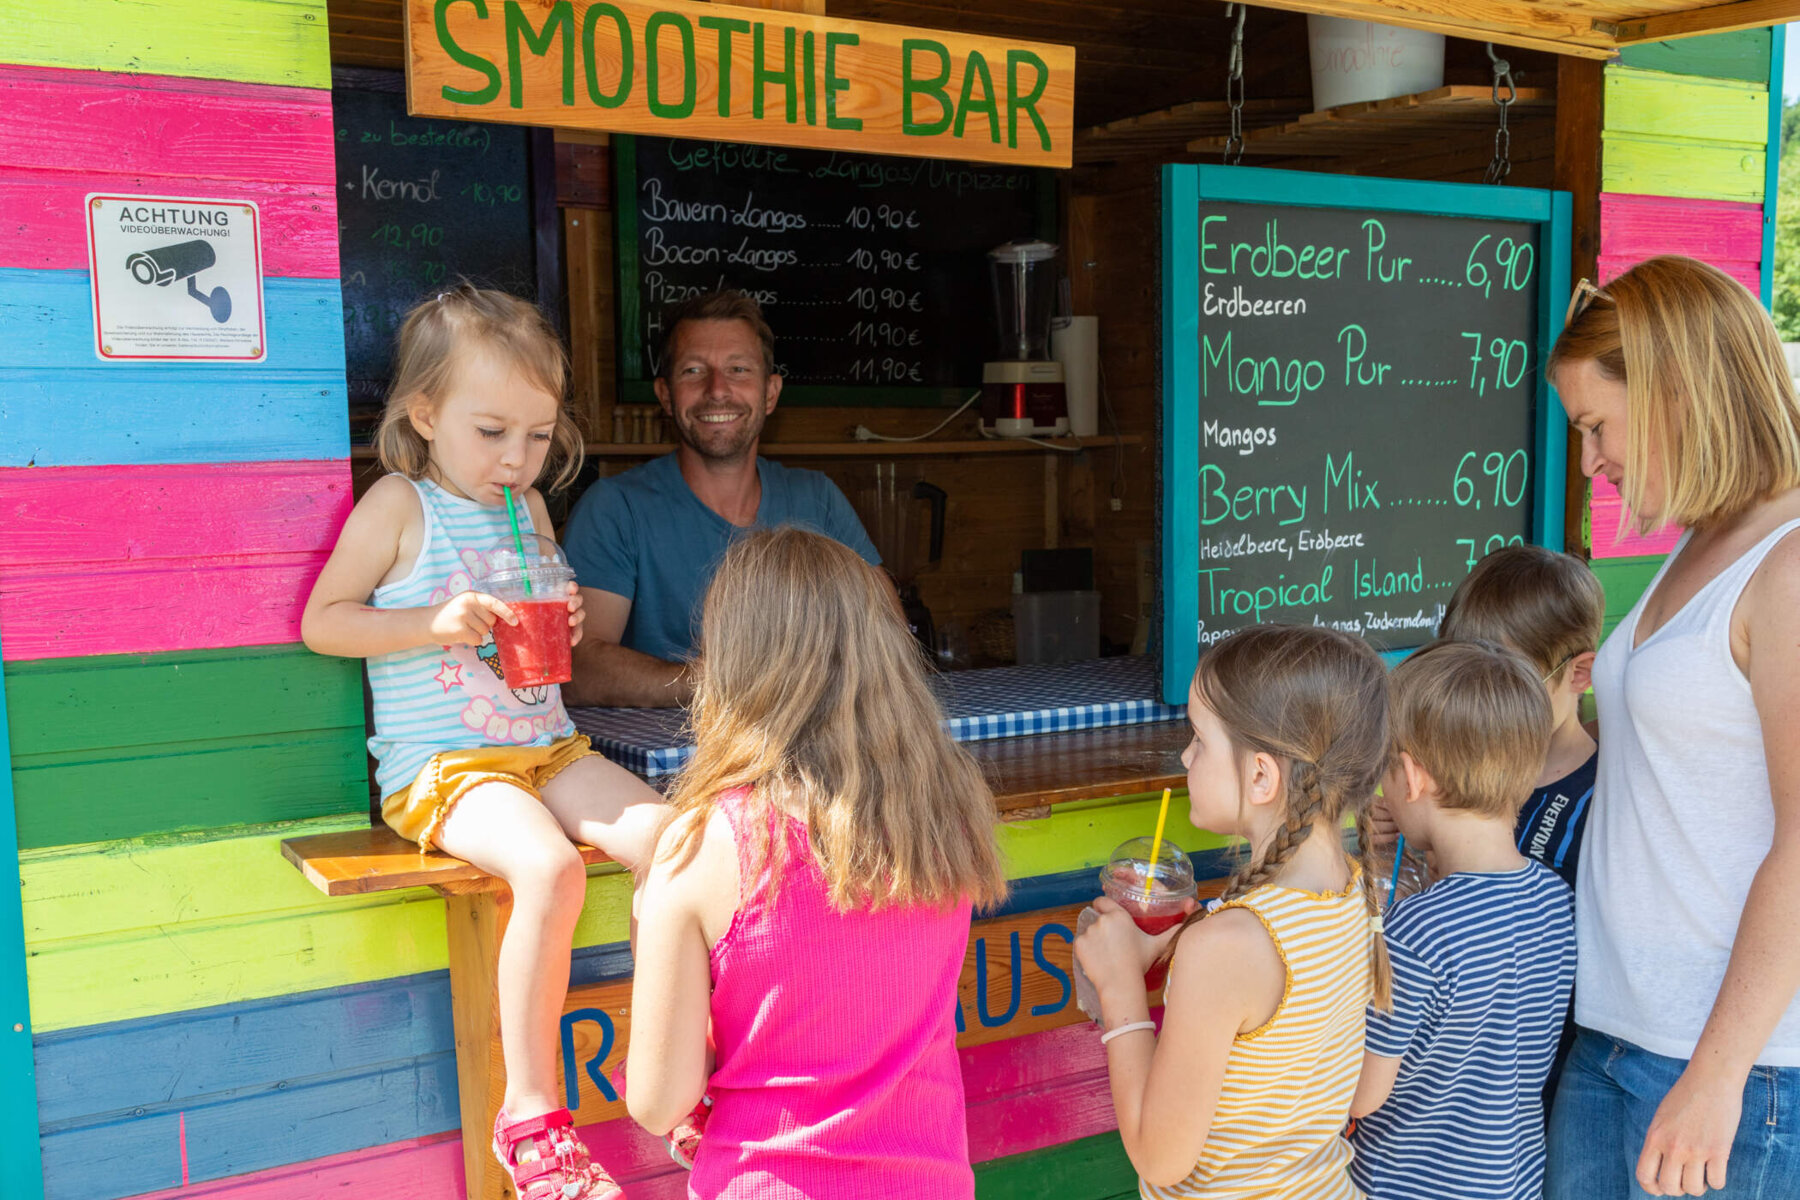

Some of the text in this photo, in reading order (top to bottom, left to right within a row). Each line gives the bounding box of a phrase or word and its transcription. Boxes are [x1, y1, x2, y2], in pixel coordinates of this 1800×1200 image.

[433, 0, 1053, 152] SMOOTHIE BAR
[119, 206, 229, 226] ACHTUNG
[642, 177, 921, 233] Bauern-Langos 10,90€
[120, 223, 231, 238] VIDEOÜBERWACHUNG!
[847, 248, 921, 274] 10,90€
[1201, 215, 1535, 298] Erdbeer Pur 6,90
[848, 287, 923, 313] 10,90€
[1203, 282, 1307, 318] Erdbeeren
[849, 321, 923, 348] 11,90€
[849, 357, 923, 384] 11,90€
[1203, 323, 1529, 406] Mango Pur 7,90
[1203, 420, 1278, 456] Mangos
[1199, 448, 1529, 527] Berry Mix 6,90
[1200, 529, 1365, 561] Heidelbeere, Erdbeere
[1198, 555, 1424, 623] Tropical Island
[1529, 793, 1571, 860] EVERYDAY
